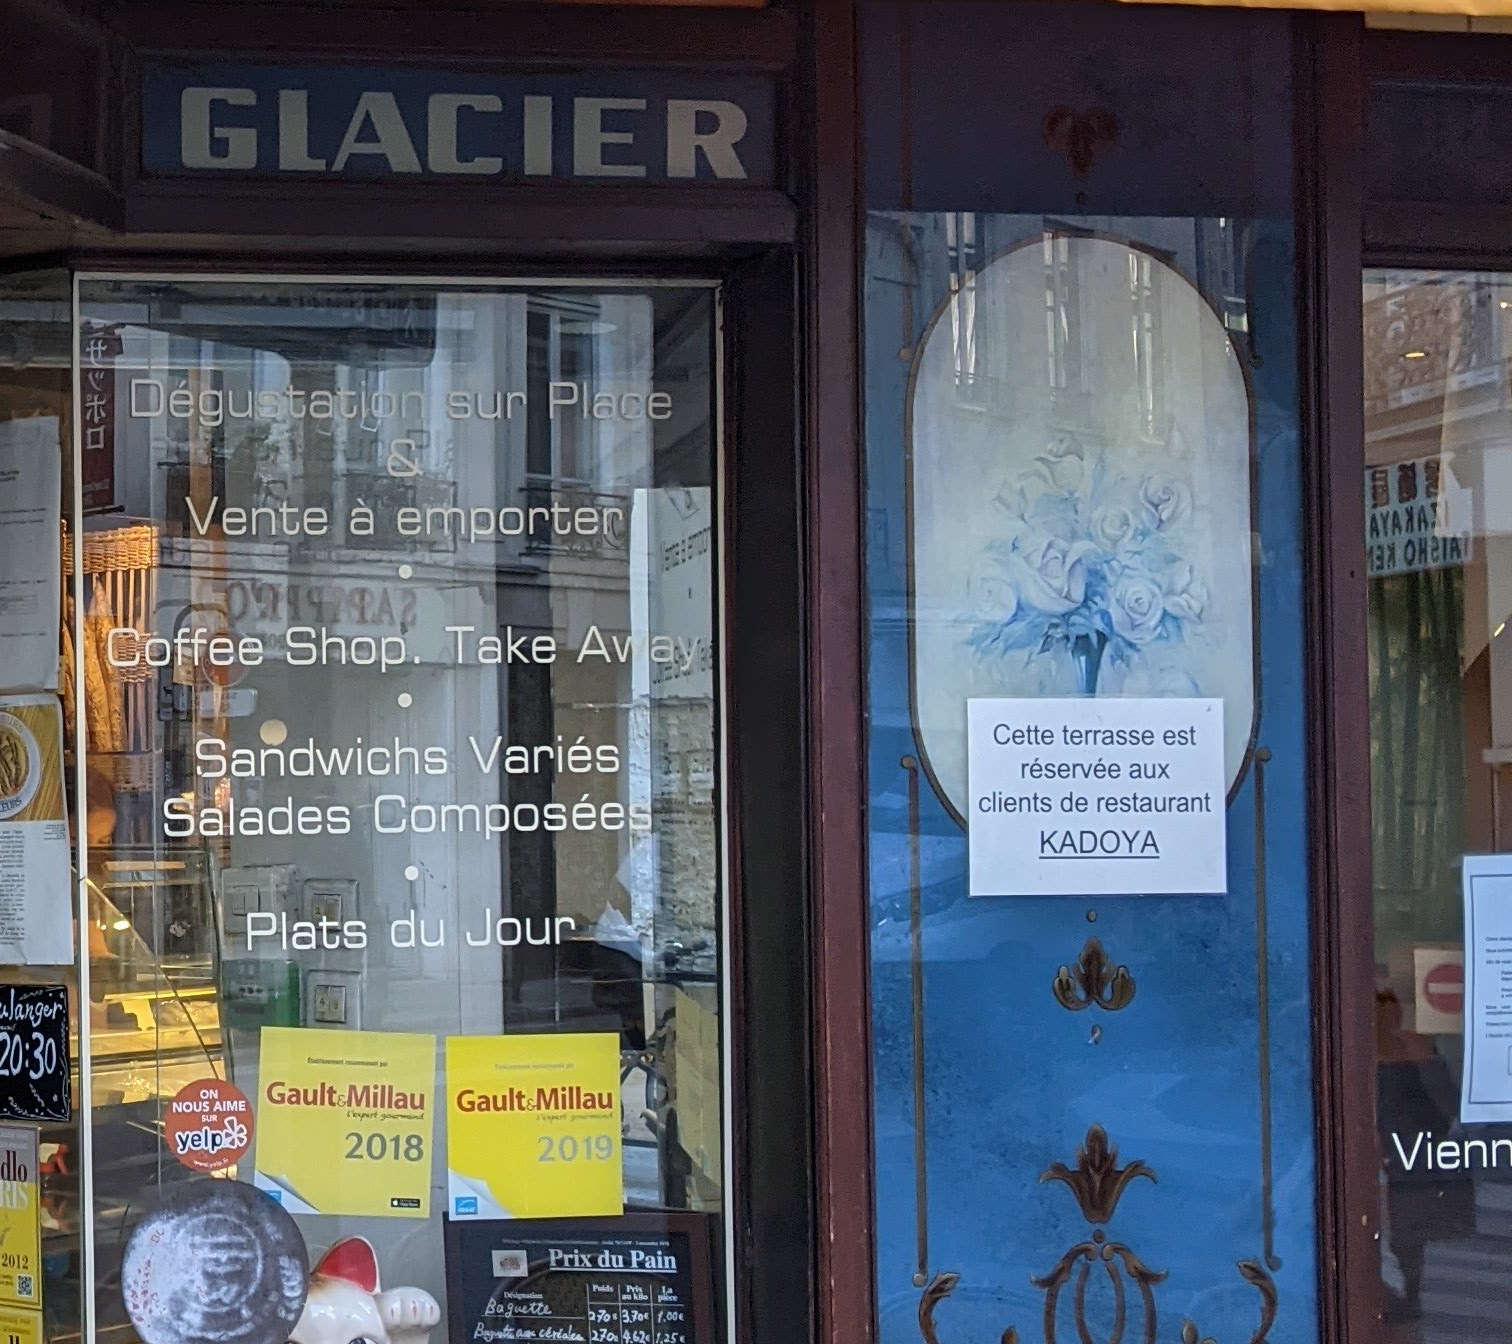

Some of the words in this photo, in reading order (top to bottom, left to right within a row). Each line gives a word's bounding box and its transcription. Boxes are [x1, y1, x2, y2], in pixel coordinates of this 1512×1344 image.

[180, 84, 750, 181] GLACIER
[129, 378, 426, 428] Dégustation
[445, 389, 527, 420] sur
[548, 381, 673, 420] Place
[387, 438, 424, 478] &
[185, 495, 329, 537] Vente
[348, 496, 375, 537] à
[396, 497, 624, 547] emporter
[106, 625, 264, 667] Coffee
[286, 625, 421, 673] Shop.
[444, 624, 557, 665] Take
[576, 624, 702, 671] Away
[993, 723, 1055, 745] Cette
[1062, 724, 1155, 746] terrasse
[1162, 725, 1197, 746] est
[194, 736, 448, 778] Sandwichs
[469, 735, 620, 775] Variés
[1021, 757, 1122, 779] réservée
[1129, 763, 1170, 779] aux
[978, 791, 1053, 813] clients
[1060, 791, 1089, 813] de
[1096, 792, 1212, 813] restaurant
[162, 797, 352, 838] Salades
[373, 794, 653, 840] Composées
[1040, 830, 1160, 855] KADOYA
[246, 910, 369, 951] Plats
[389, 910, 446, 949] du
[465, 907, 576, 948] Jour
[172, 1101, 212, 1113] NOUS
[213, 1100, 247, 1112] AIME
[200, 1089, 219, 1100] ON
[266, 1081, 426, 1111] Gault&Millau
[456, 1085, 614, 1113] Gault&Millau
[201, 1114, 218, 1123] SUR
[176, 1127, 224, 1153] yelp
[344, 1131, 425, 1162] 2018
[538, 1134, 614, 1163] 2019
[1, 1253, 29, 1270] 2012
[548, 1248, 592, 1268] Prix
[597, 1249, 624, 1268] du
[630, 1250, 677, 1270] Pain
[593, 1284, 614, 1293] Poids
[626, 1284, 643, 1293] Prix
[484, 1297, 553, 1319] Baguette
